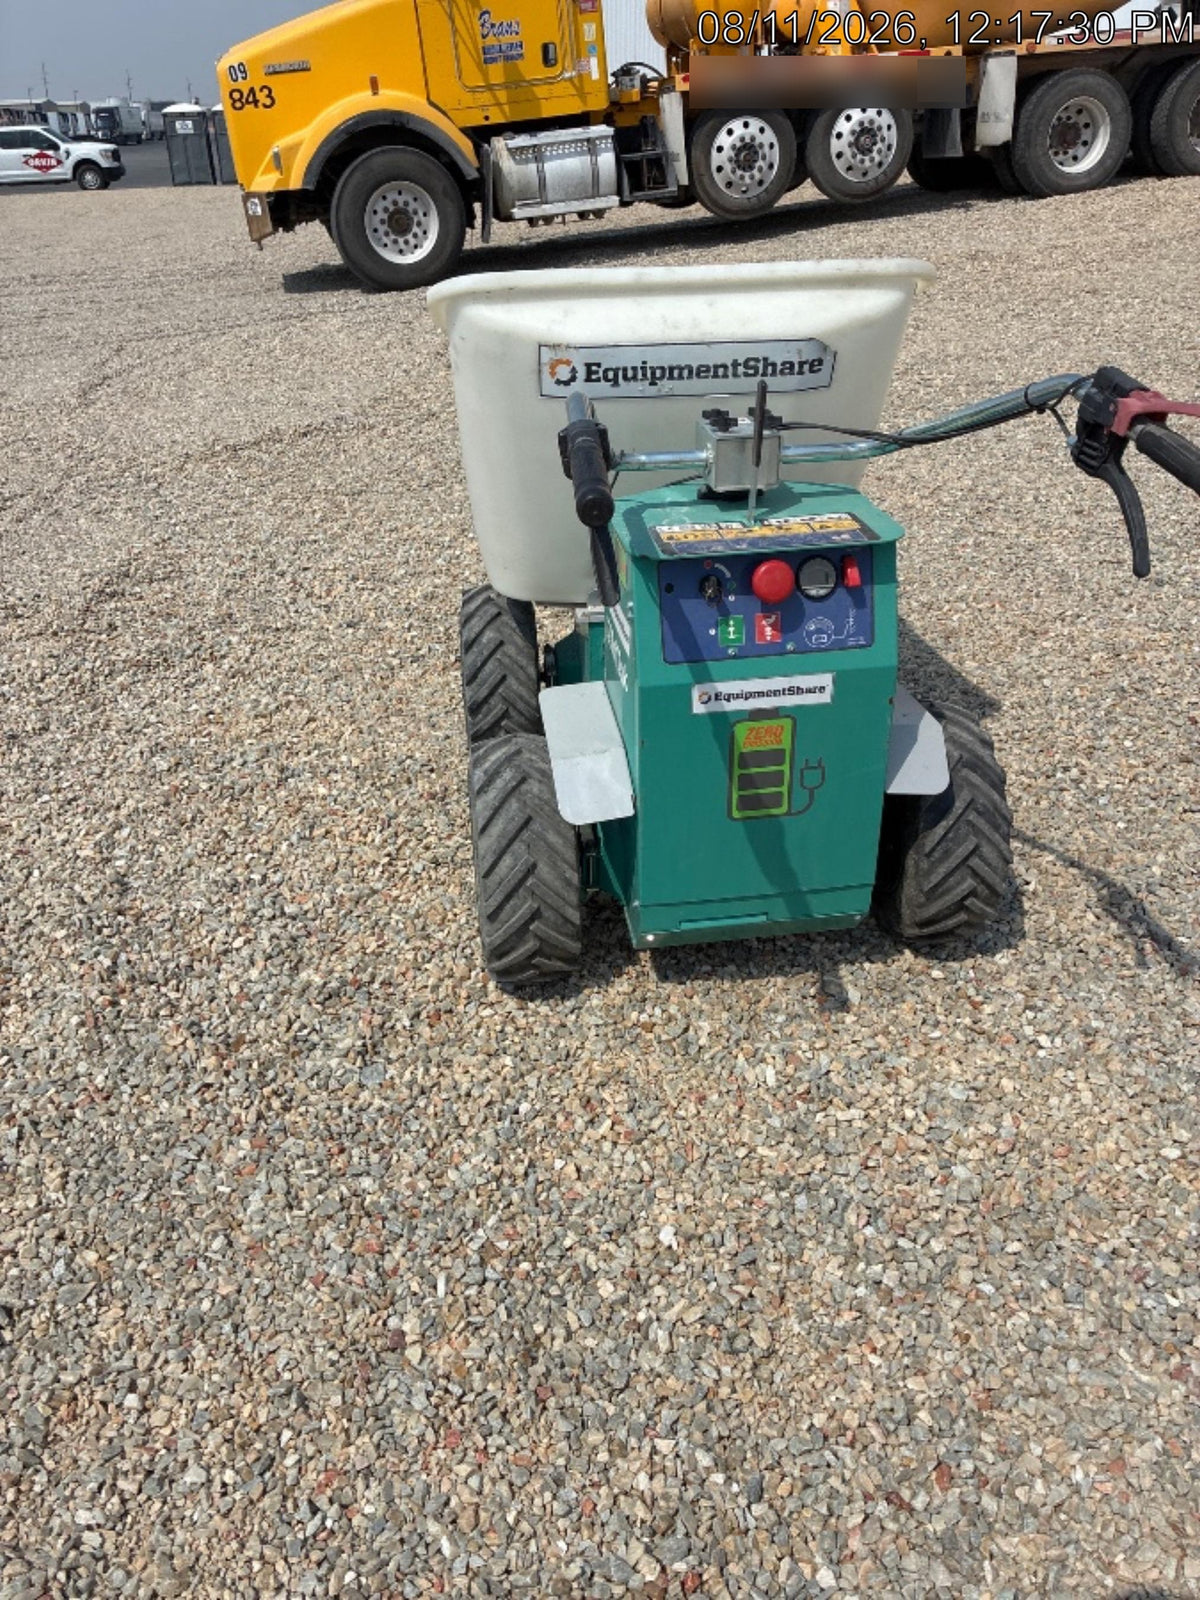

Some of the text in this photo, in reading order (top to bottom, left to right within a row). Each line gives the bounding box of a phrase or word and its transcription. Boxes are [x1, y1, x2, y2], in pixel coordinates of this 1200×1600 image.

[228, 62, 248, 82] 09
[229, 85, 276, 111] 843
[584, 356, 824, 387] EquipmentShare
[714, 685, 826, 703] EquipmentShare
